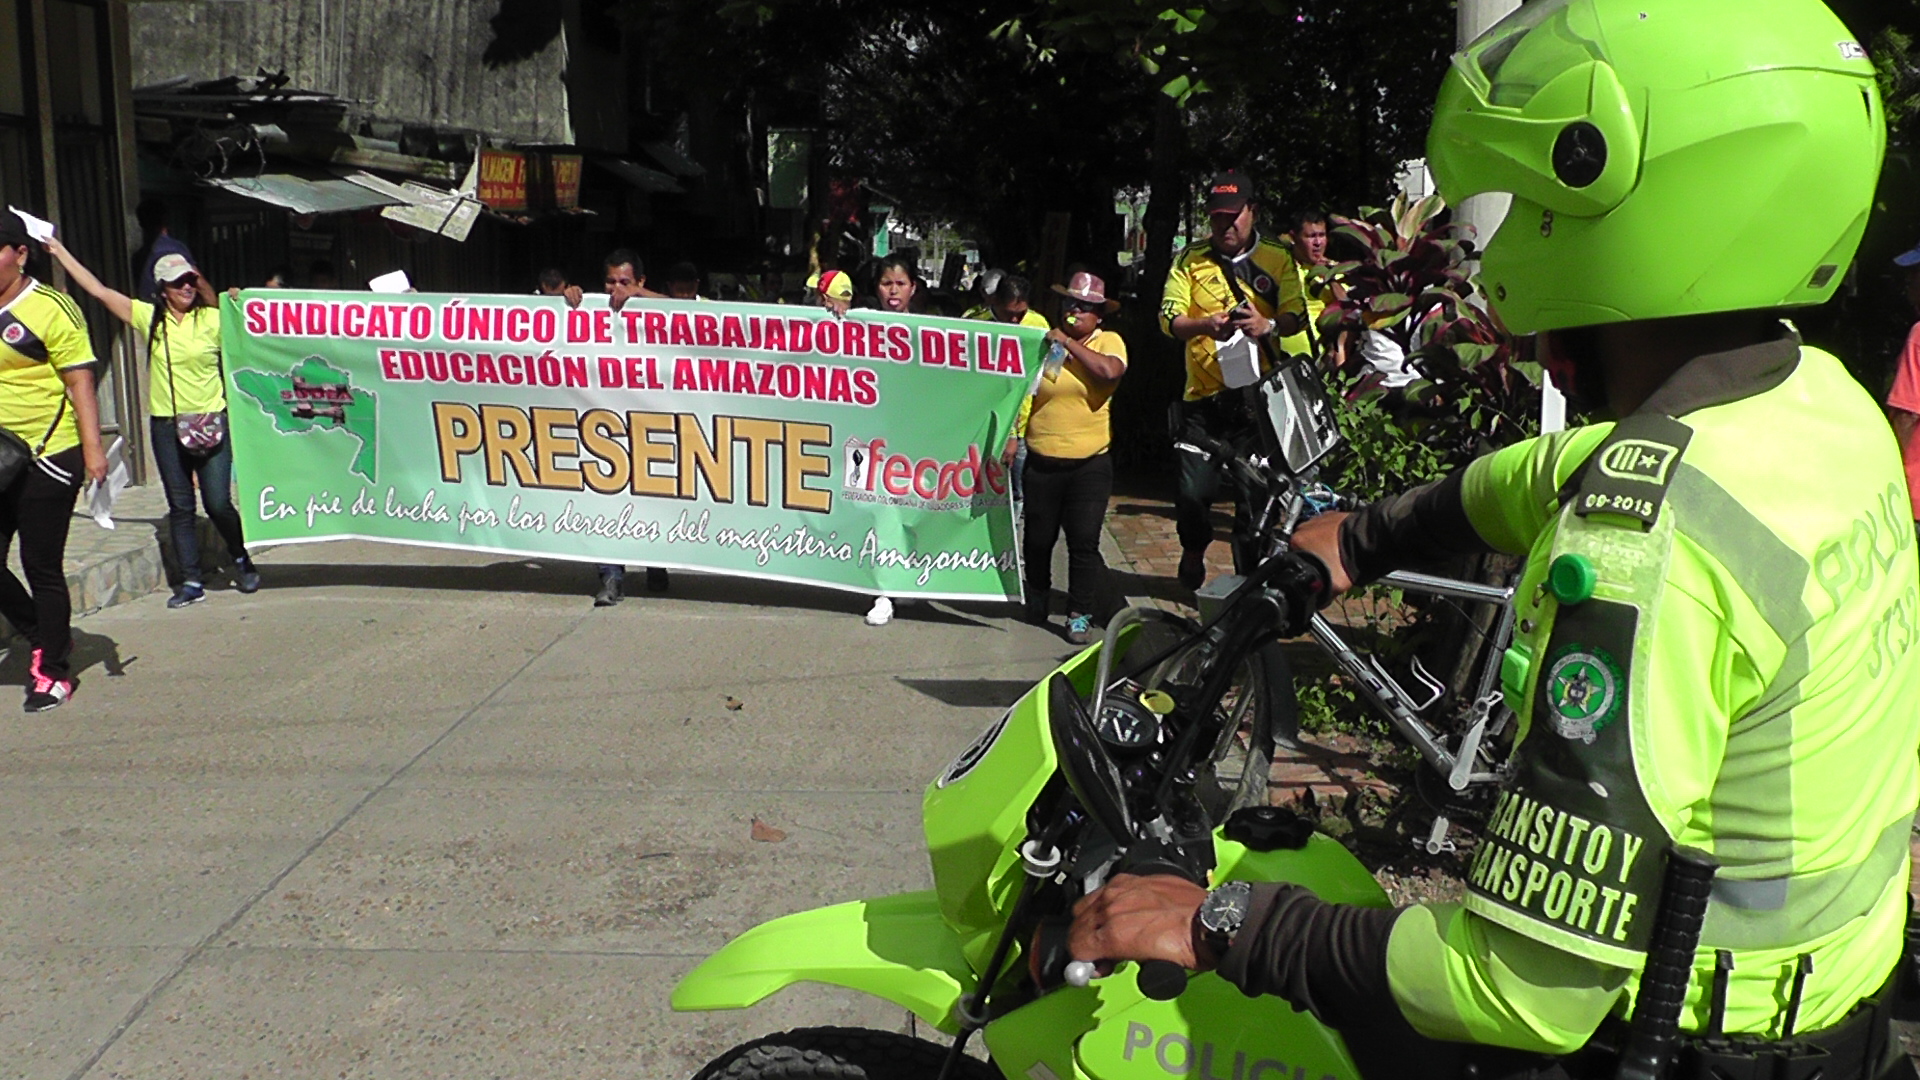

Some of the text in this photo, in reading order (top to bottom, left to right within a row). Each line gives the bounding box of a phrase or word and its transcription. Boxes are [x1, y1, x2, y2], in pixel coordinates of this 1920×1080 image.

[245, 299, 1024, 375] SINDICATO ÚNICO DE TRABAJADORES DE LA
[379, 349, 877, 405] EDUCACIÓN DEL AMAZONAS
[432, 400, 832, 514] PRESENTE
[258, 486, 297, 521] En
[304, 489, 343, 528] pie
[351, 486, 377, 516] de
[384, 486, 451, 523] lucha
[457, 501, 500, 534] por
[505, 495, 547, 532] los
[554, 500, 661, 542] derechos
[667, 508, 710, 544] del
[716, 523, 852, 566] magisterio
[1618, 832, 1643, 883] Y
[1122, 1020, 1338, 1080] POLIC
